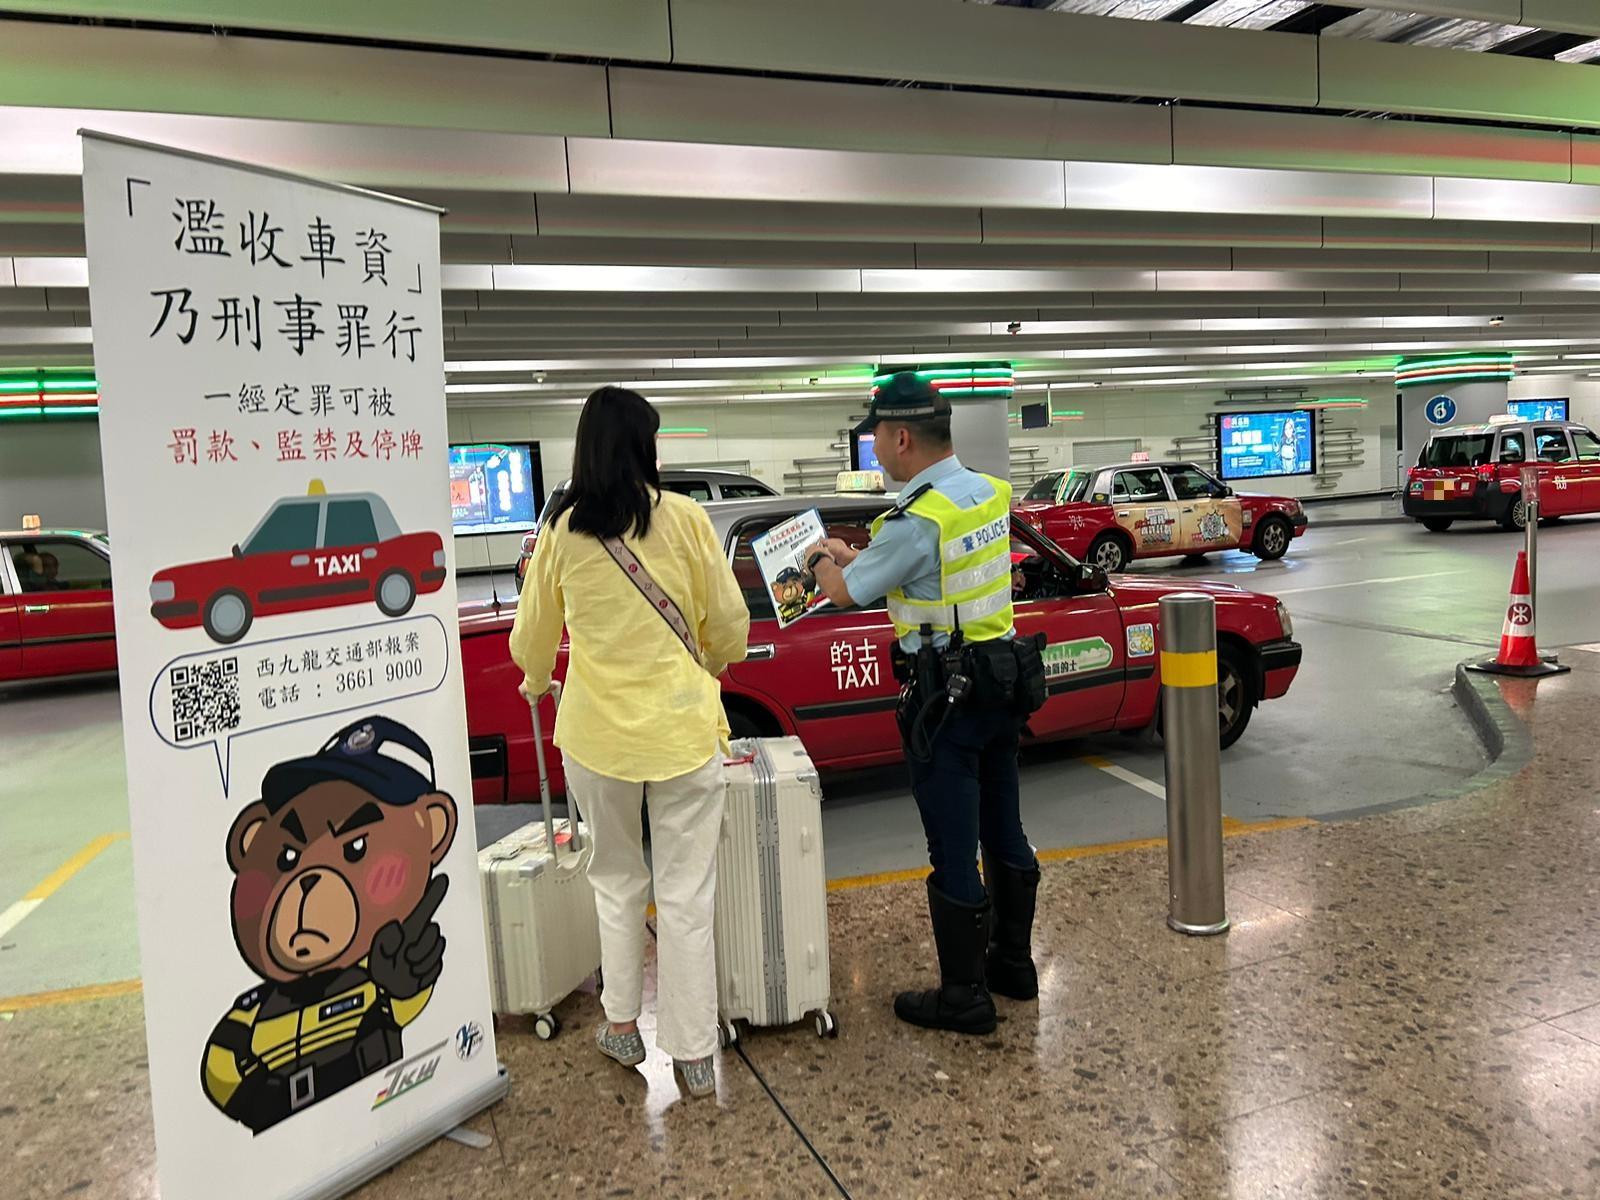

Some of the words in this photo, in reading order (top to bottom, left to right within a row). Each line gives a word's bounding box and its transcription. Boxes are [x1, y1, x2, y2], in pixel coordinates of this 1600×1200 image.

[150, 288, 423, 363] 乃刑事罪行
[204, 382, 396, 417] 一經定罪可被
[166, 427, 424, 465] 罰款、監禁及停牌
[976, 519, 1006, 546] POLICE
[315, 553, 361, 577] TAXI
[256, 631, 419, 678] 西九龍交通部報案
[830, 638, 877, 665] 的士
[336, 668, 374, 694] 3661
[386, 658, 423, 682] 9000
[831, 662, 880, 690] TAXI
